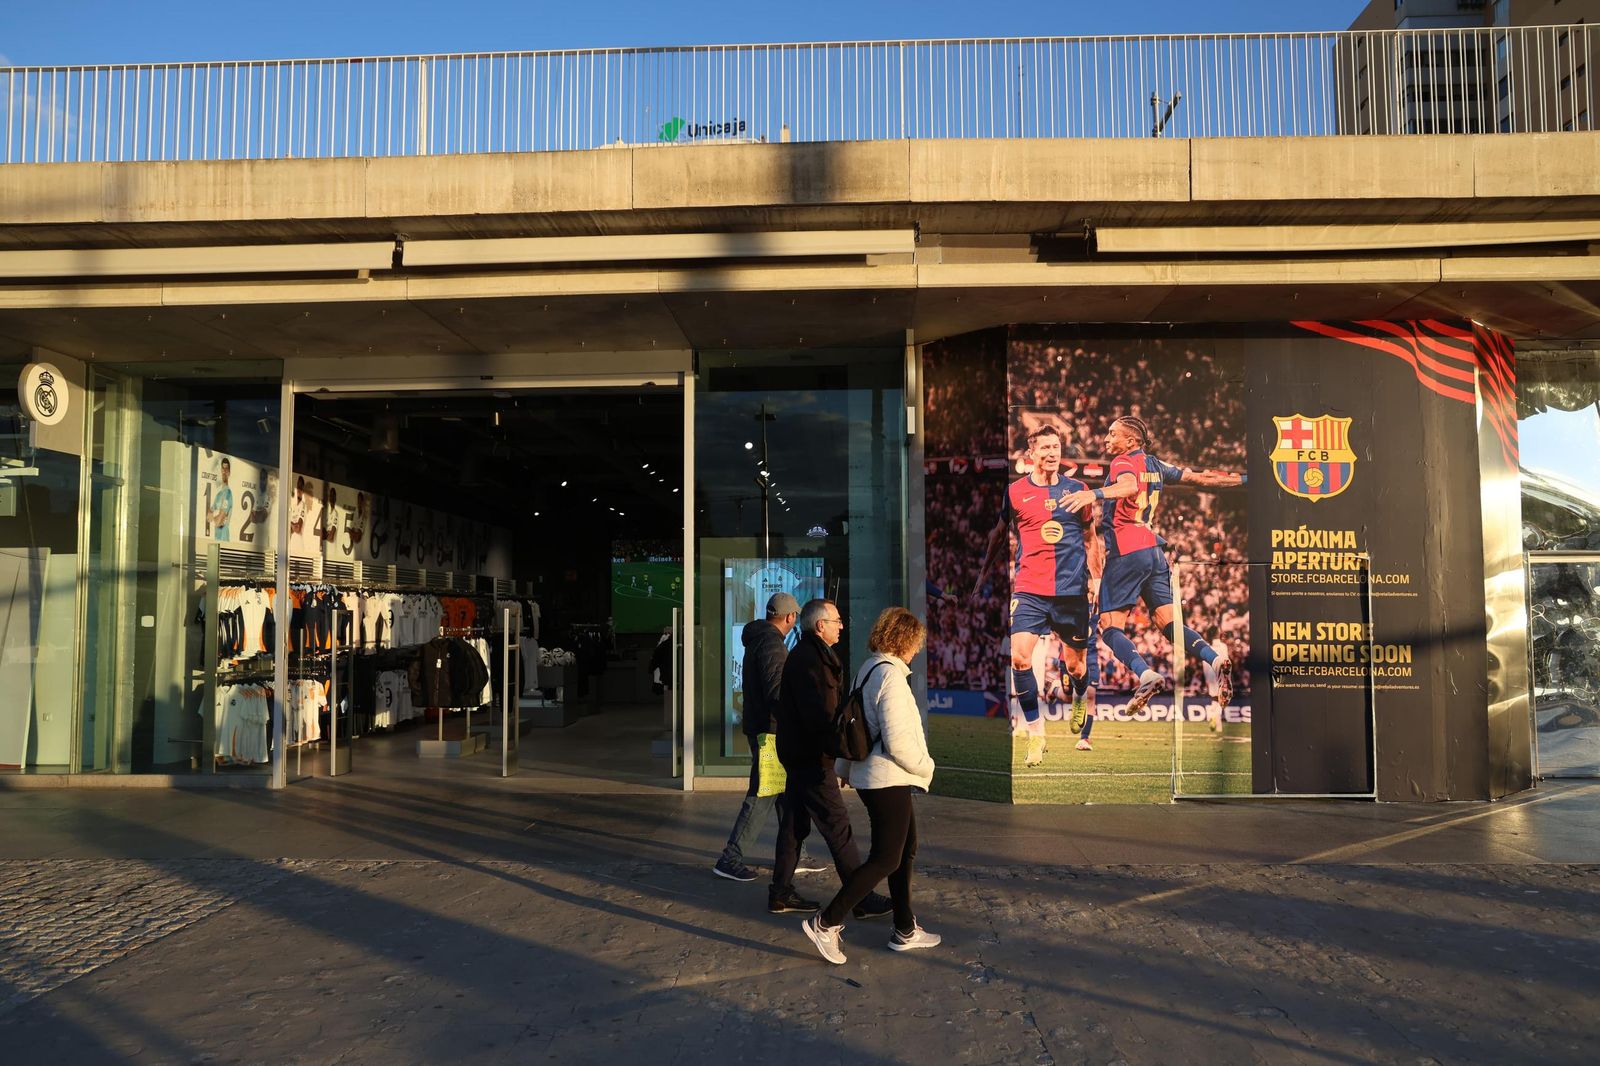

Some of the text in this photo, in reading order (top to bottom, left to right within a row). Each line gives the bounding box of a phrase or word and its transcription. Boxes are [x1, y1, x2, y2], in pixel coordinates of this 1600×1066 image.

[687, 117, 746, 138] Unicaja
[1297, 450, 1329, 461] FCB
[239, 490, 255, 542] 2
[342, 512, 354, 556] 5
[1271, 524, 1357, 549] PRÓXIMA
[1271, 551, 1368, 571] APERTURA
[1271, 573, 1410, 584] STORE.FCBARCELONA.COM
[1272, 621, 1374, 641] NEW STORE
[1272, 643, 1412, 664] OPENING SOON
[1272, 665, 1412, 678] STORE.FCBARCELONA.COM
